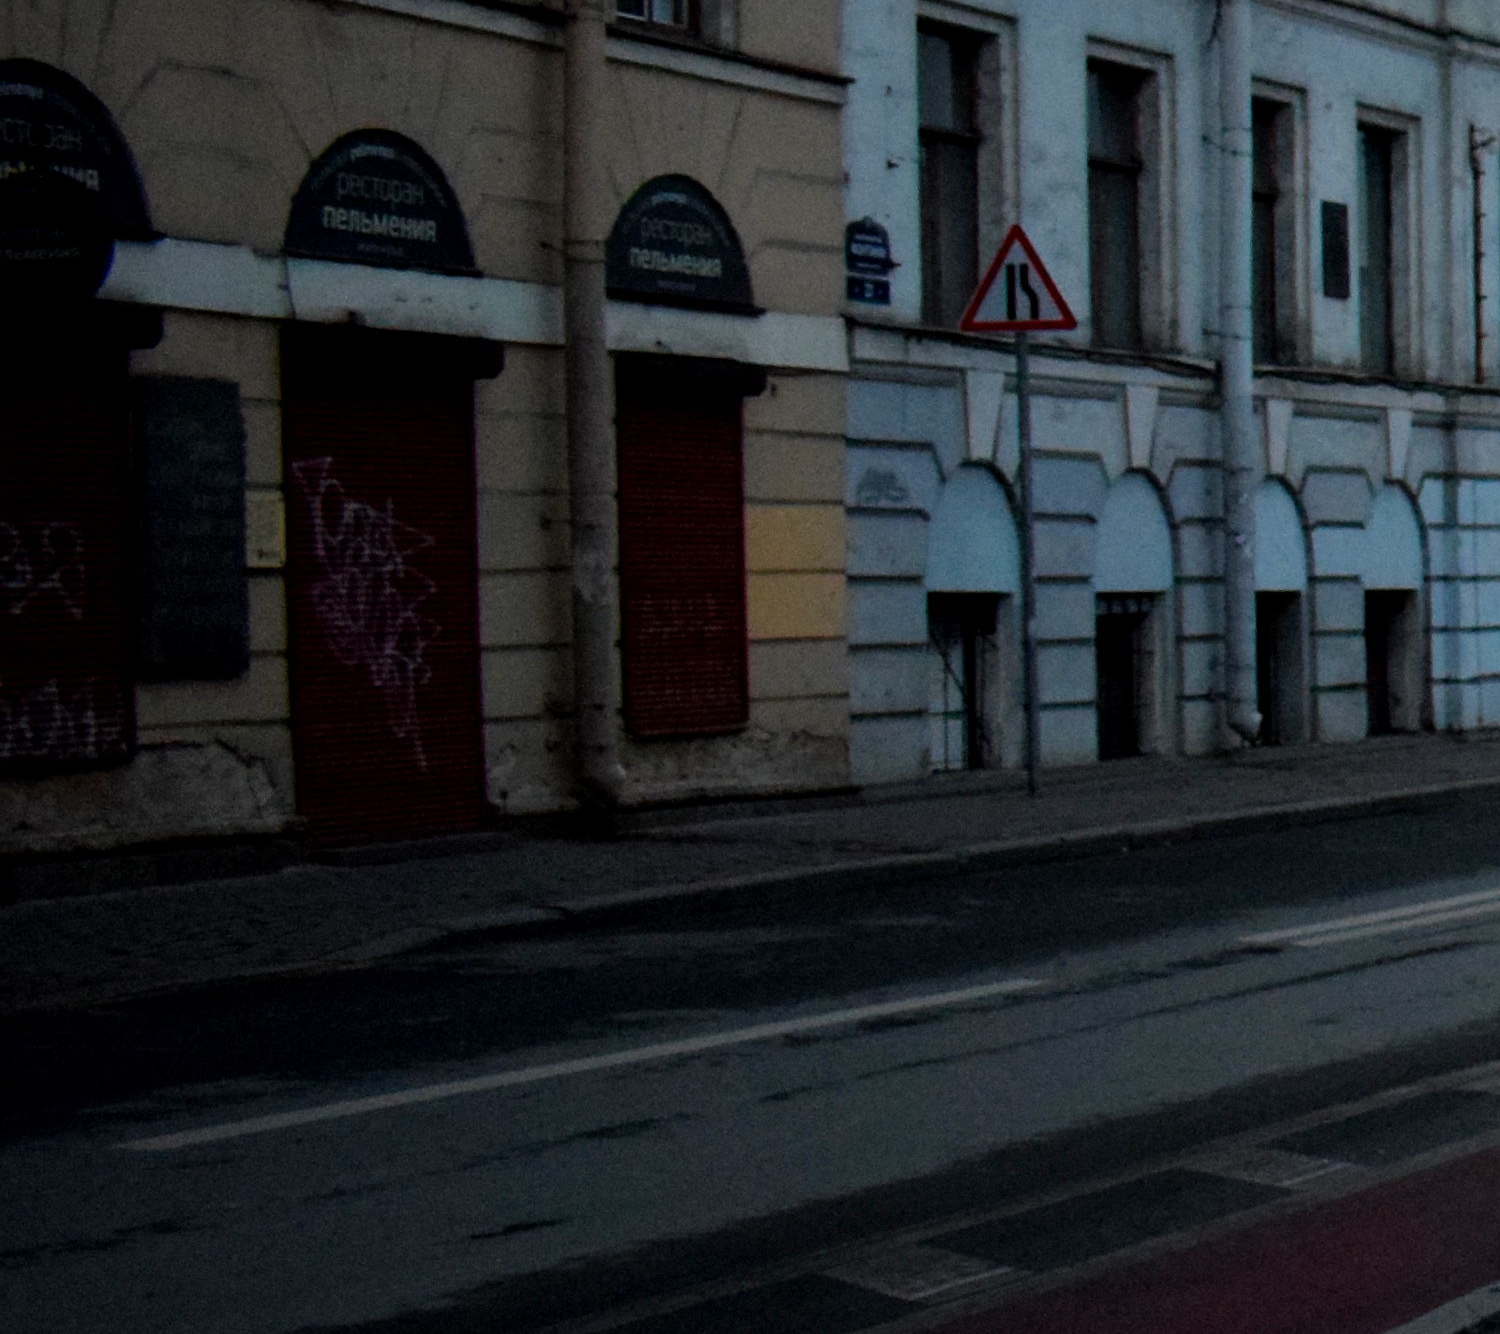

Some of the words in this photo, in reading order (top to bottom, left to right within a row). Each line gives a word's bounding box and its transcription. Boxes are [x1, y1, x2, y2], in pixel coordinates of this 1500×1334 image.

[337, 172, 424, 209] ресторан
[322, 205, 436, 242] пельмения
[629, 247, 722, 277] пельмения
